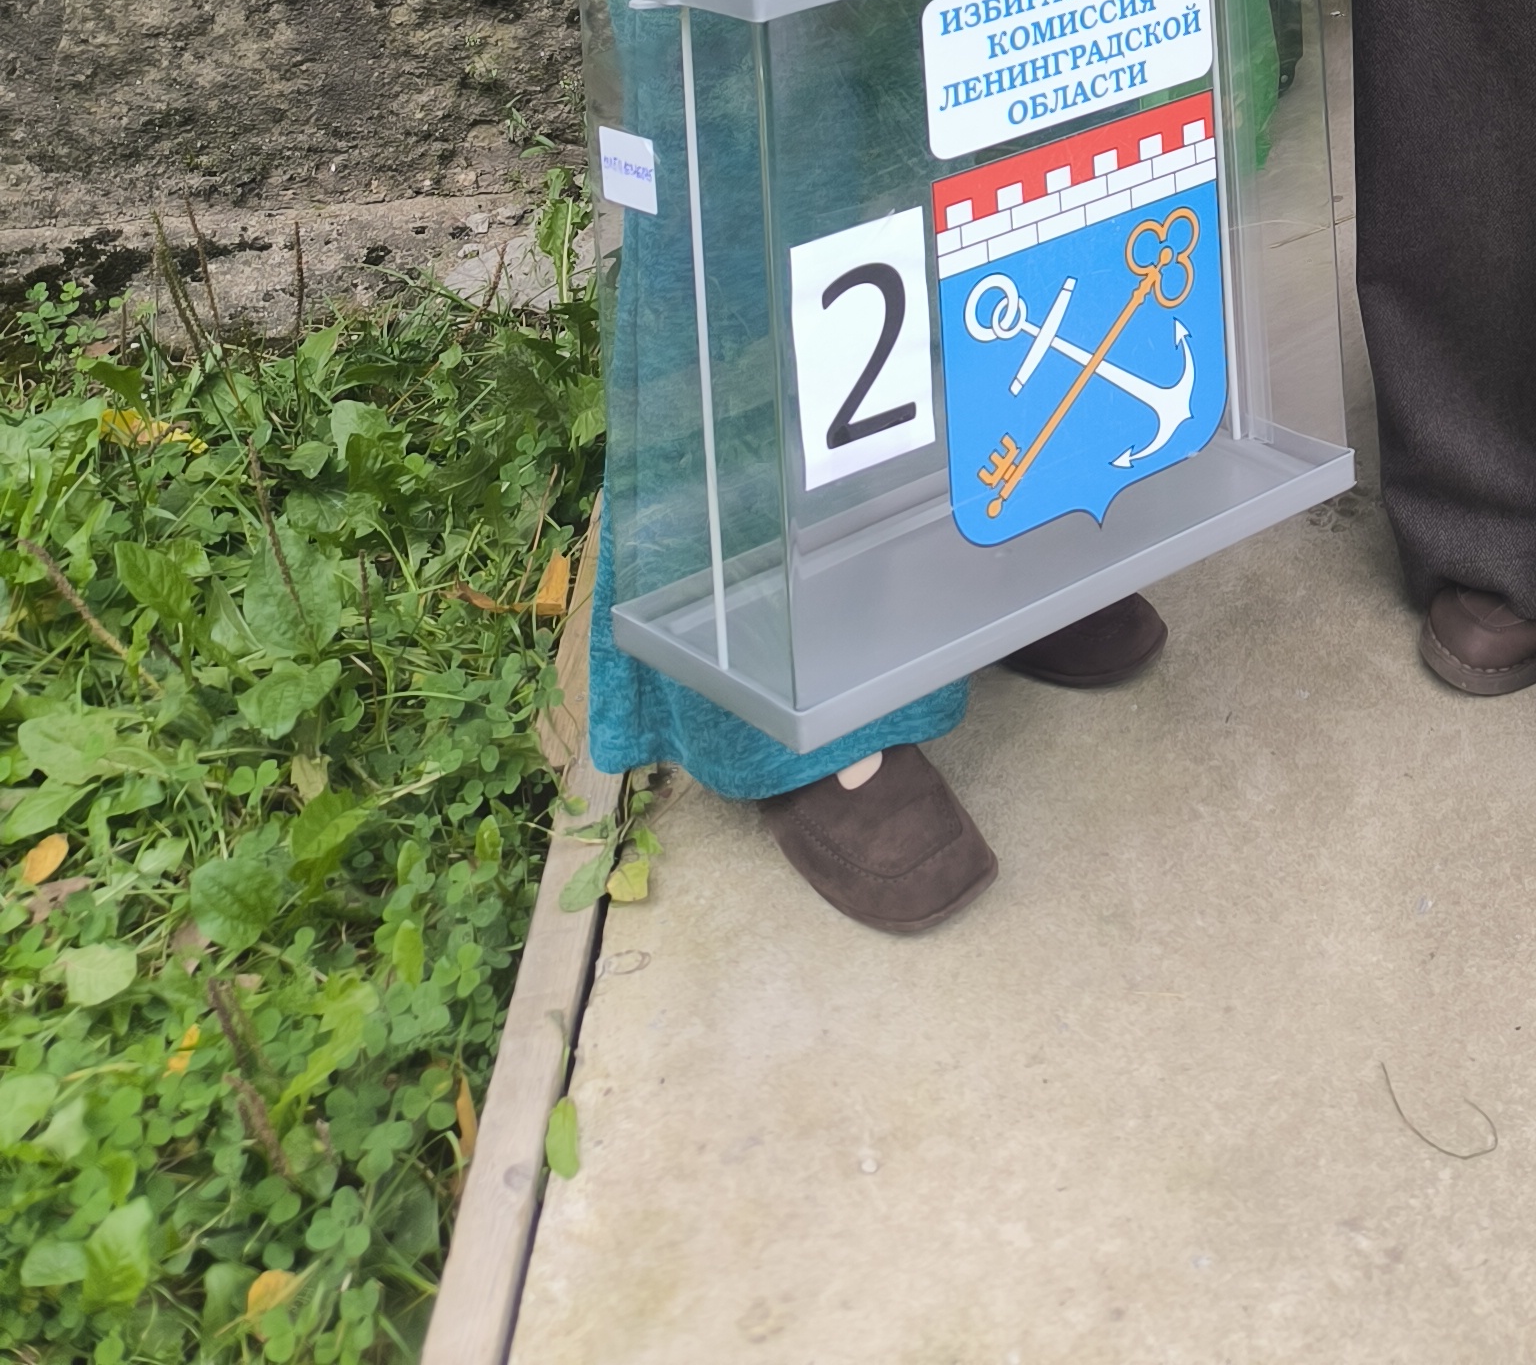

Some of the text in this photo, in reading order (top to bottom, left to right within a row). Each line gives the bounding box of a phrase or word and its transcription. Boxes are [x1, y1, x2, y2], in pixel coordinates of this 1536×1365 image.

[938, 2, 1203, 112] ЛЕНИНГРАДСКОЙ
[1006, 60, 1148, 126] ОБЛАСТИ
[819, 260, 919, 451] 2
